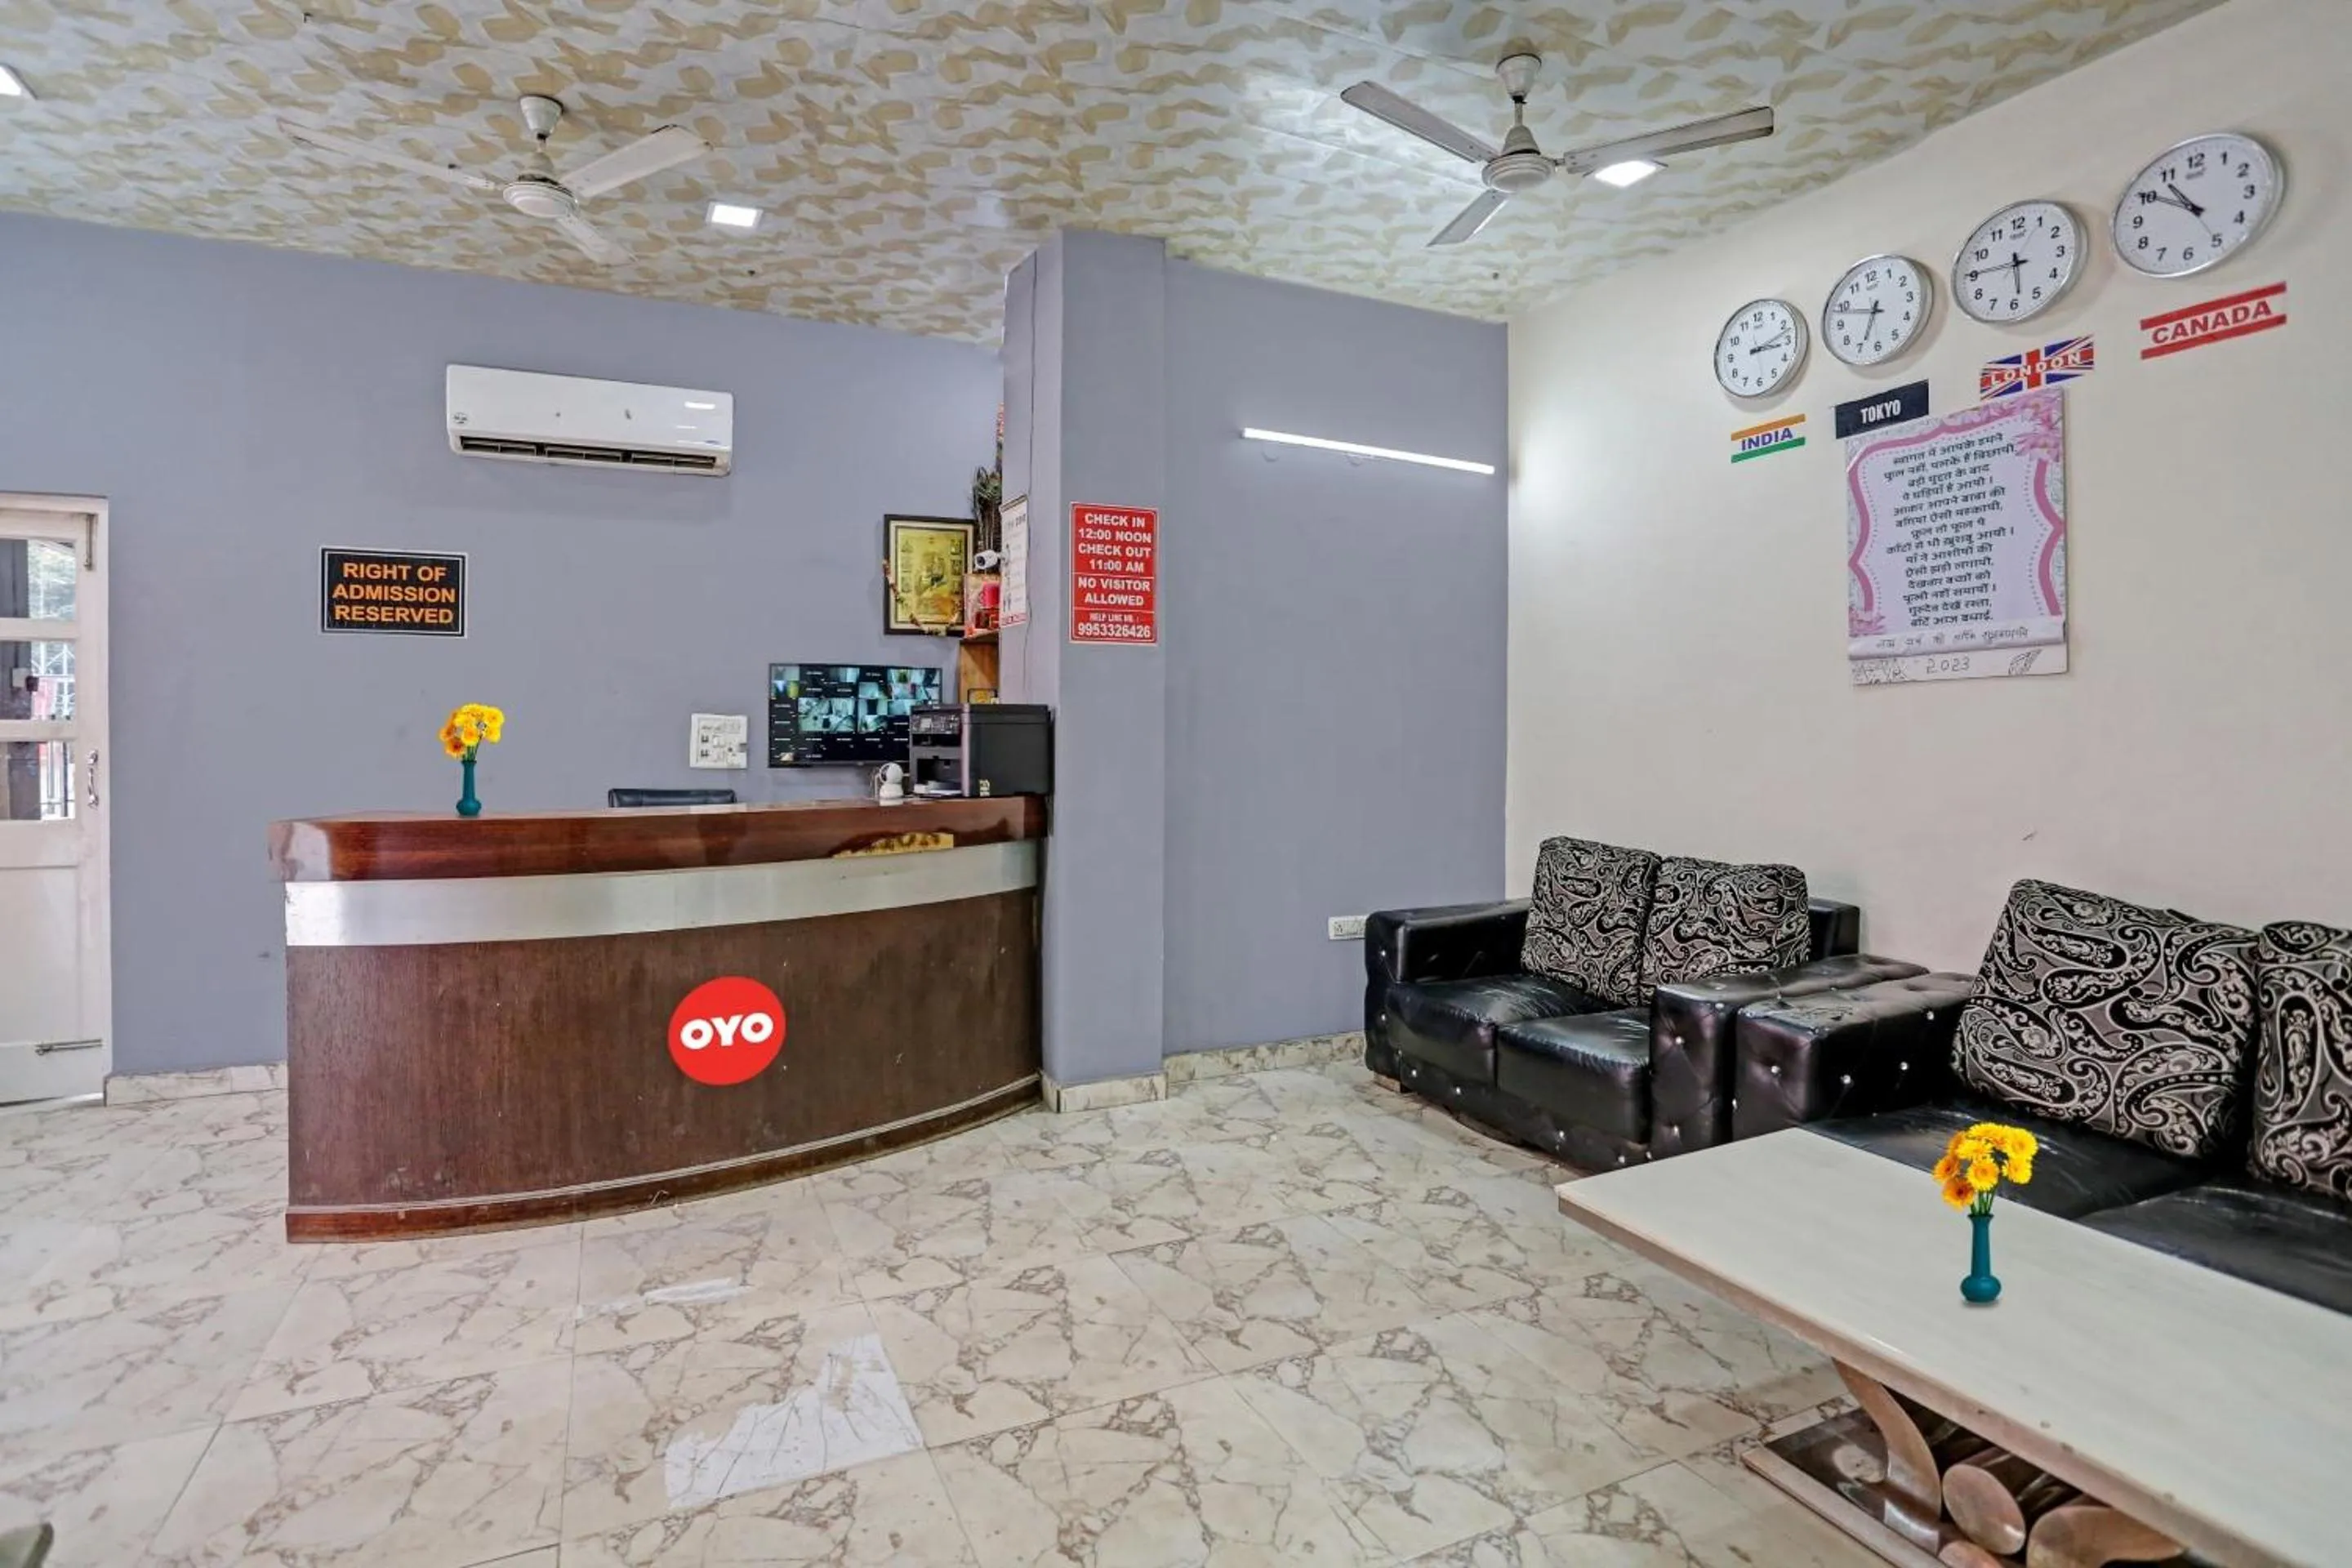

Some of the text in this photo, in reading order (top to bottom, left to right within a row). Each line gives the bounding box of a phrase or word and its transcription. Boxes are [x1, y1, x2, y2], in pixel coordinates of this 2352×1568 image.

[2187, 153, 2204, 168] 12
[2221, 151, 2227, 164] 1
[2161, 167, 2176, 182] 11
[2237, 163, 2249, 178] 2
[2138, 190, 2157, 205] 10
[2243, 185, 2255, 199] 3
[2011, 216, 2025, 230] 12
[2037, 216, 2042, 227] 1
[2133, 215, 2143, 229] 9
[2234, 210, 2244, 225] 4
[1990, 229, 2002, 242] 11
[2051, 225, 2060, 239] 2
[2138, 236, 2149, 249] 8
[2211, 233, 2222, 247] 5
[1975, 248, 1988, 261] 10
[2056, 245, 2065, 257] 3
[2156, 247, 2167, 261] 7
[2183, 247, 2194, 261] 6
[1865, 270, 1877, 283] 12
[1886, 268, 1891, 279] 1
[1969, 270, 1978, 282] 9
[2049, 267, 2058, 278] 4
[1899, 275, 1907, 287] 2
[1849, 283, 1859, 294] 11
[1974, 288, 1983, 300] 8
[2032, 287, 2041, 299] 5
[1906, 291, 1913, 302] 3
[1838, 301, 1850, 313] 10
[1989, 298, 1998, 310] 7
[2009, 298, 2018, 310] 6
[1753, 312, 1763, 322] 12
[1771, 312, 1775, 320] 1
[1903, 311, 1910, 321] 4
[2151, 301, 2271, 344] CANADA
[1740, 322, 1748, 332] 11
[1781, 319, 1787, 330] 2
[1837, 319, 1844, 330] 9
[1731, 336, 1740, 346] 10
[1785, 335, 1792, 345] 3
[1843, 335, 1851, 345] 8
[1891, 328, 1899, 341] 5
[1856, 343, 1863, 354] 7
[1874, 341, 1882, 351] 6
[1727, 354, 1734, 363] 9
[1781, 352, 1788, 362] 4
[1732, 368, 1738, 378] 8
[1771, 368, 1777, 379] 5
[1991, 351, 2081, 386] LONDON
[1742, 377, 1748, 387] 7
[1757, 377, 1763, 386] 6
[1860, 400, 1901, 423] TOKYO
[1741, 427, 1793, 451] INDIA
[1085, 514, 1145, 528] CHECK IN
[1079, 528, 1152, 543] 12:00 NOON
[1079, 543, 1152, 558] CHECK OUT
[343, 563, 447, 581] RIGHT OF
[1089, 559, 1144, 572] 11:00 AM
[1078, 577, 1150, 591] NO VISITOR
[332, 583, 456, 603] ADMISSION
[1085, 593, 1144, 606] ALLOWED
[335, 605, 453, 623] RESERVED
[1090, 612, 1106, 621] HELP
[1078, 622, 1151, 637] 9953326426
[1926, 657, 1971, 675] 2023
[680, 1012, 774, 1049] OYO
